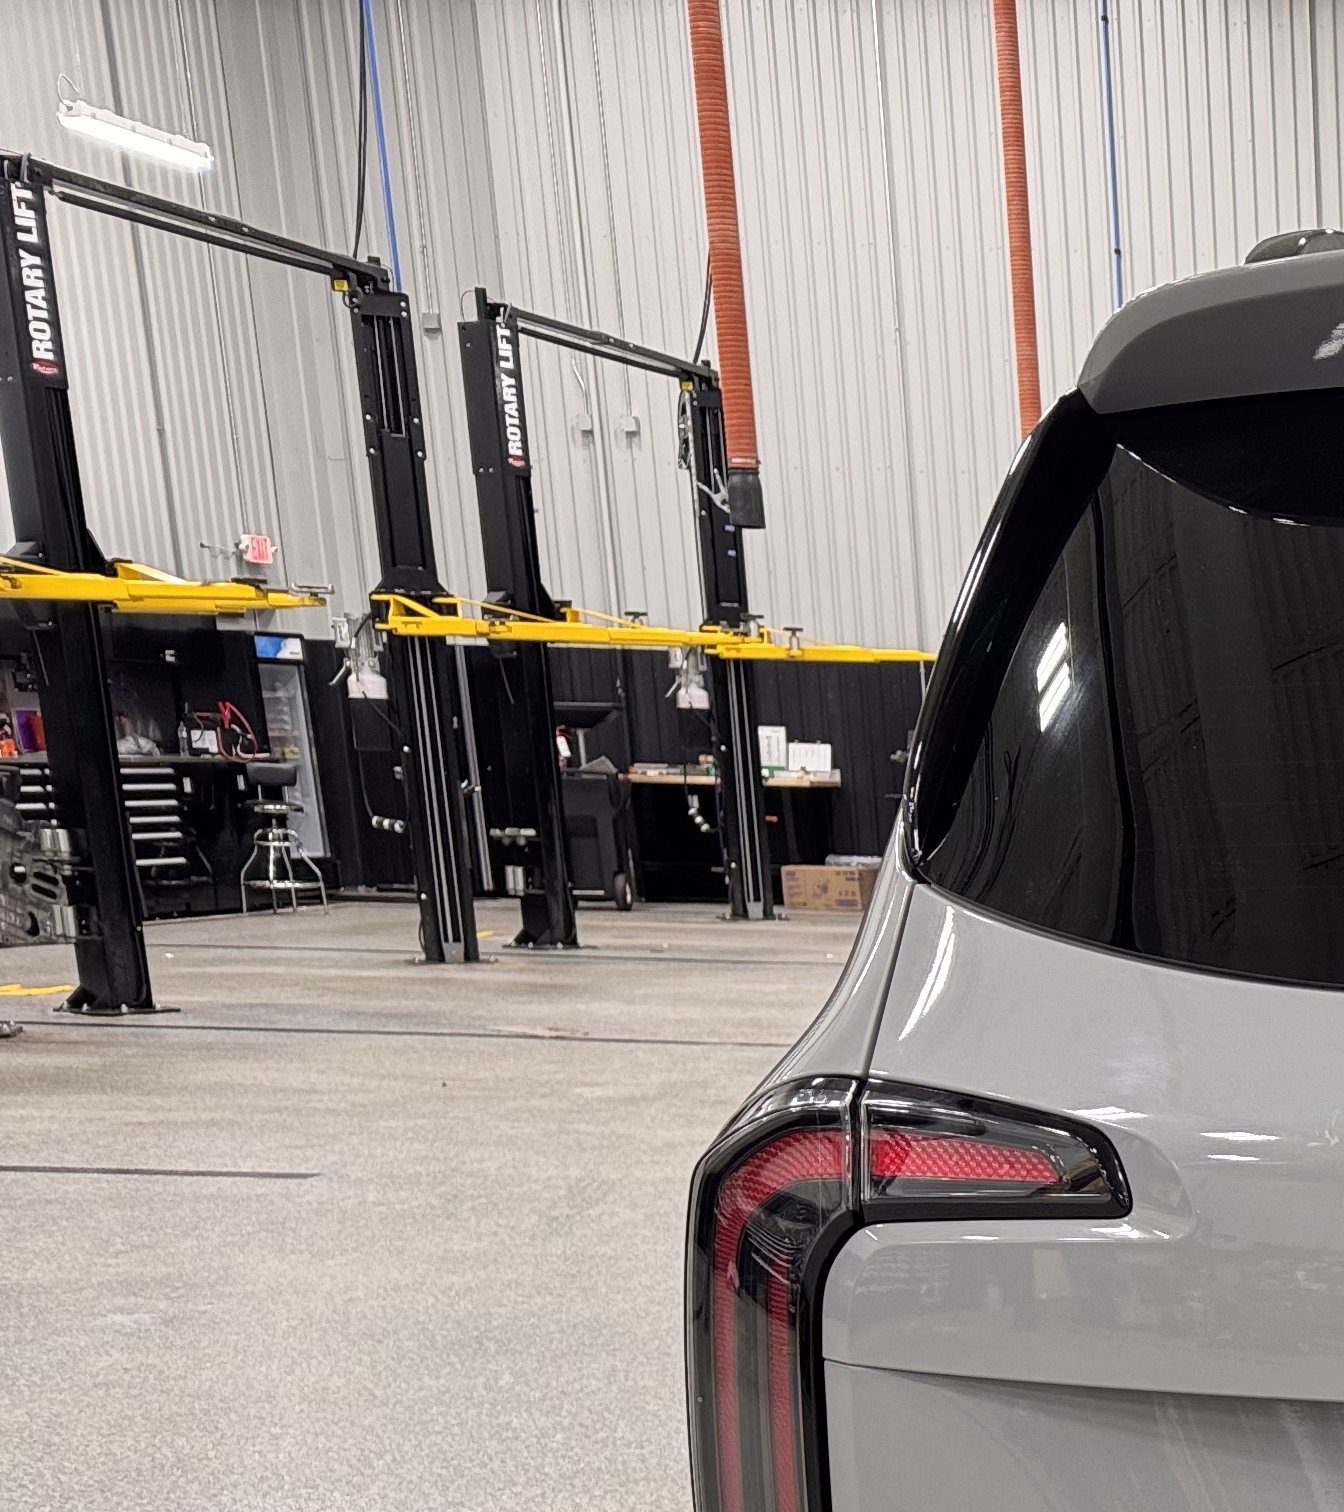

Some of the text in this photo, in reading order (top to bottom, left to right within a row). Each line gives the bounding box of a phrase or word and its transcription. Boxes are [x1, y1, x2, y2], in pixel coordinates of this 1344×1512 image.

[10, 182, 39, 243] LIFT
[19, 249, 55, 360] ROTARY
[496, 323, 515, 370] LIFT
[501, 373, 524, 456] ROTARY
